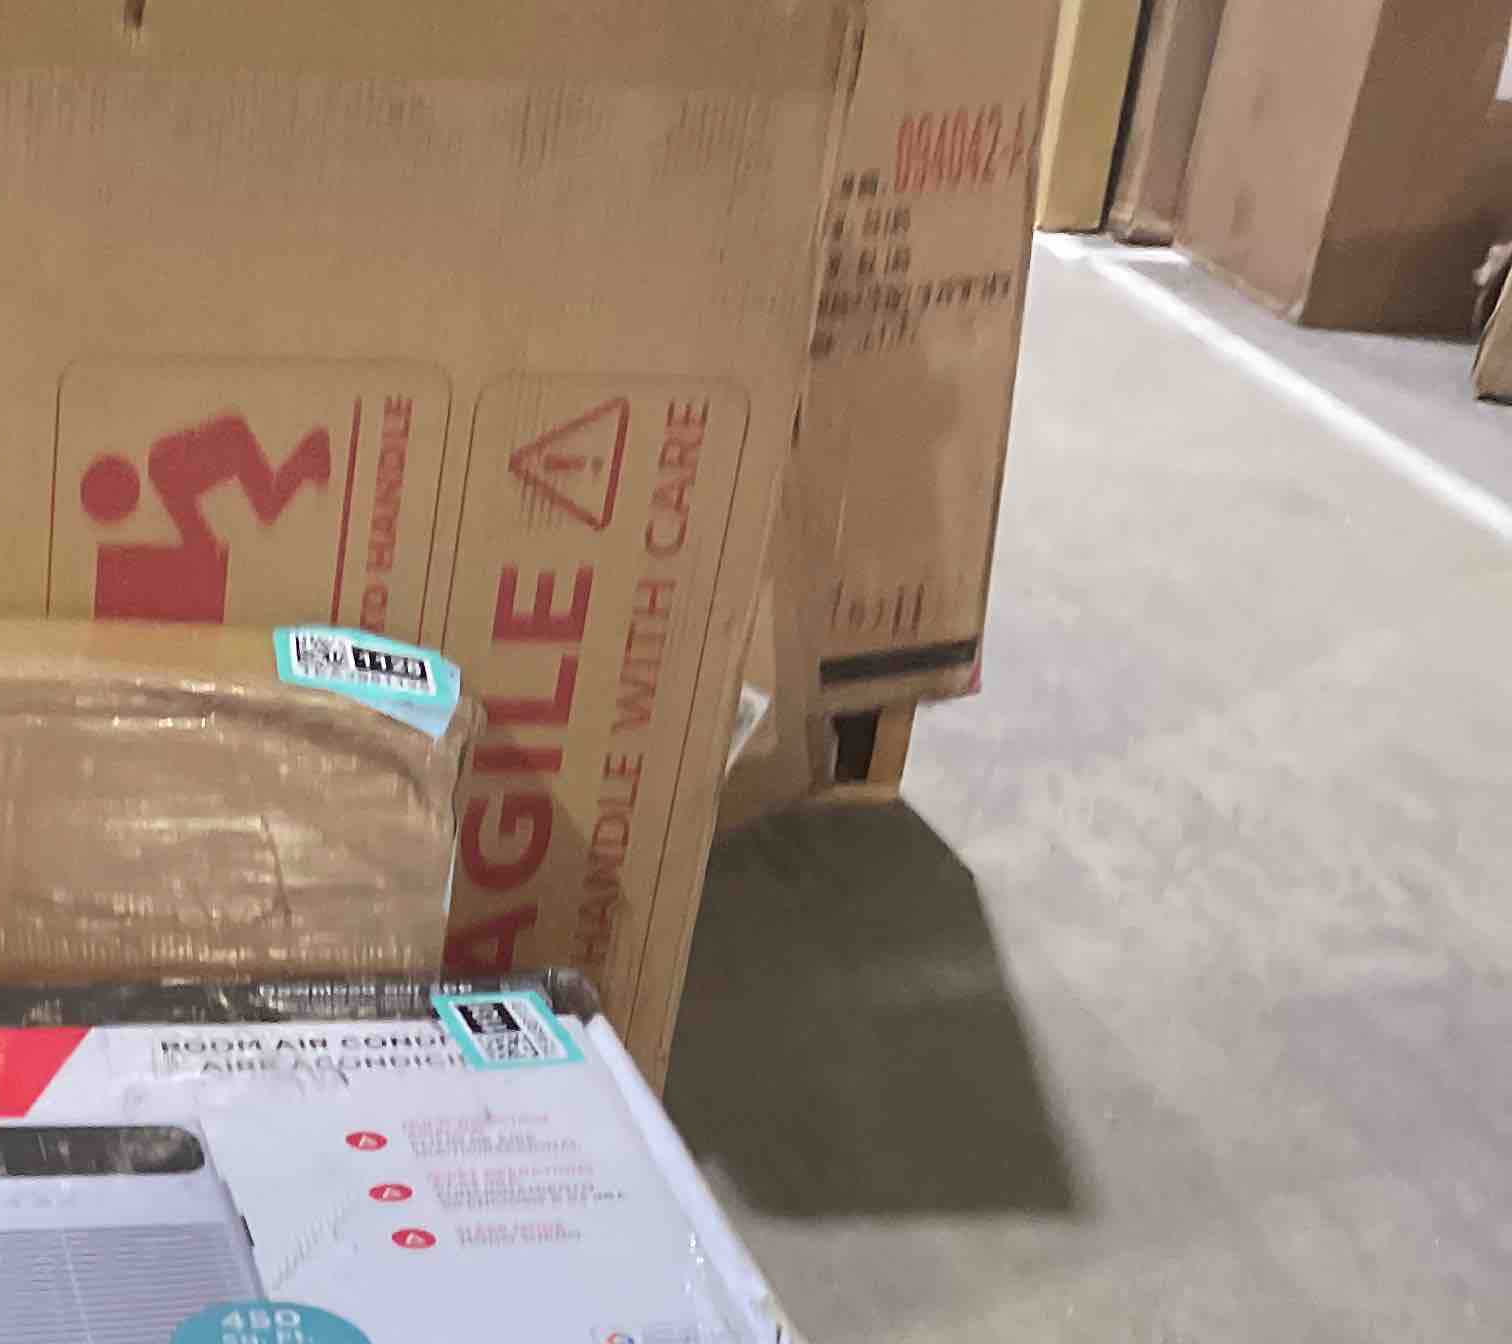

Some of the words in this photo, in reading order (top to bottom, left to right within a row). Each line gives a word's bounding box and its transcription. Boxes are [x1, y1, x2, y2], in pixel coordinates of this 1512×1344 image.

[365, 394, 414, 574] HANDLE
[443, 562, 594, 976] AGILE
[570, 753, 643, 966] HANDLE
[610, 577, 677, 735] WITH
[644, 398, 711, 557] CARE
[160, 1036, 262, 1054] ROOM
[275, 1035, 328, 1052] AIR
